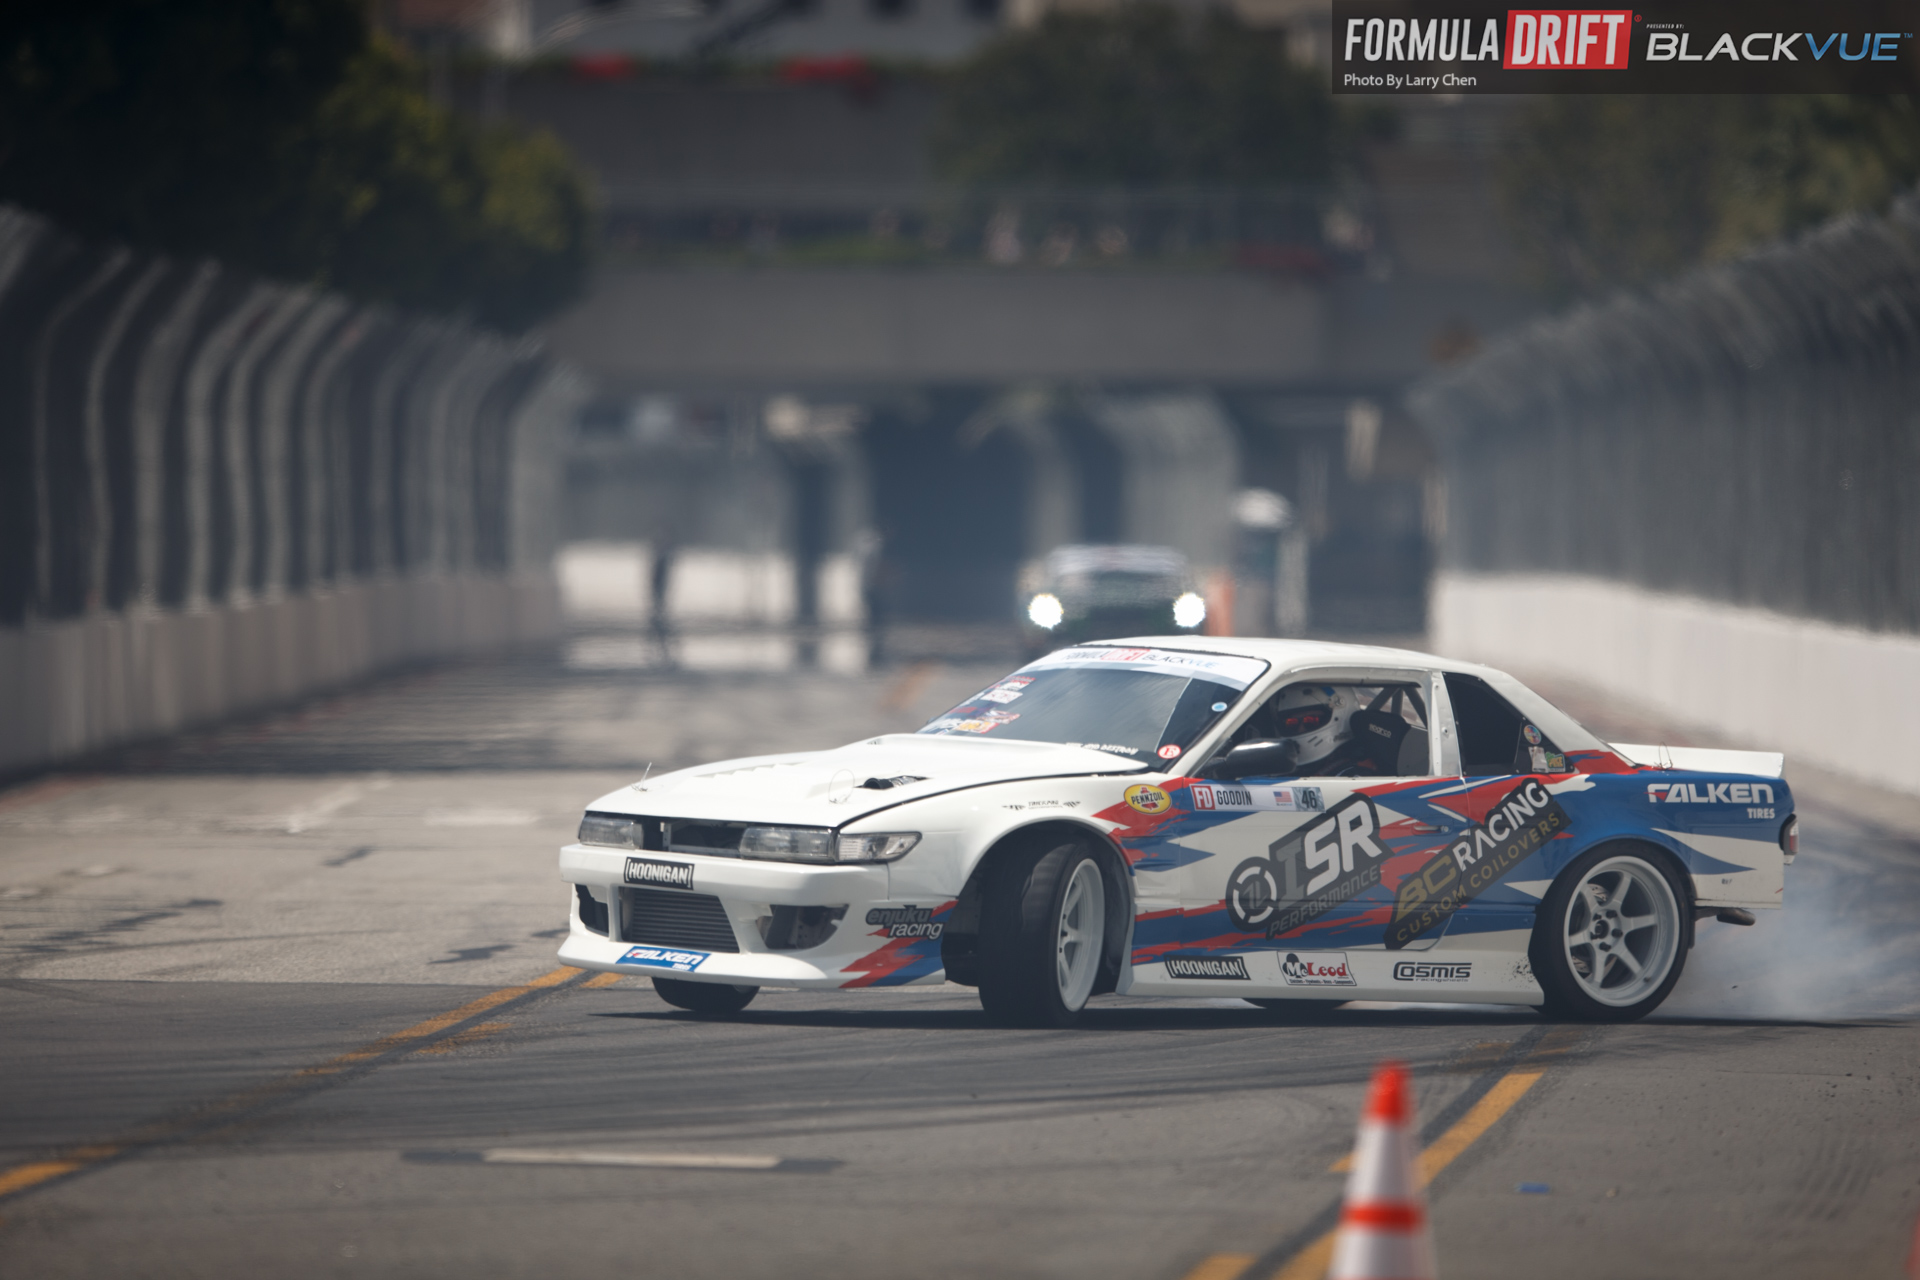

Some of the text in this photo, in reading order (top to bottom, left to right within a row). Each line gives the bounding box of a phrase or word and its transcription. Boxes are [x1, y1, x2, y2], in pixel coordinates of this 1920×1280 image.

[1130, 792, 1164, 805] PENNZOIL
[1195, 787, 1317, 810] FD GOODIN 46
[1646, 783, 1775, 803] FALKEN
[1747, 808, 1775, 819] TIRES
[1396, 813, 1560, 941] CUSTOM COILOVERS
[1269, 865, 1378, 937] PERFORMANCE
[867, 906, 931, 927] enjuku
[889, 923, 944, 940] racing
[625, 948, 704, 965] FALKEN
[1286, 961, 1347, 977] McLeod
[1393, 961, 1472, 981] COSMIS
